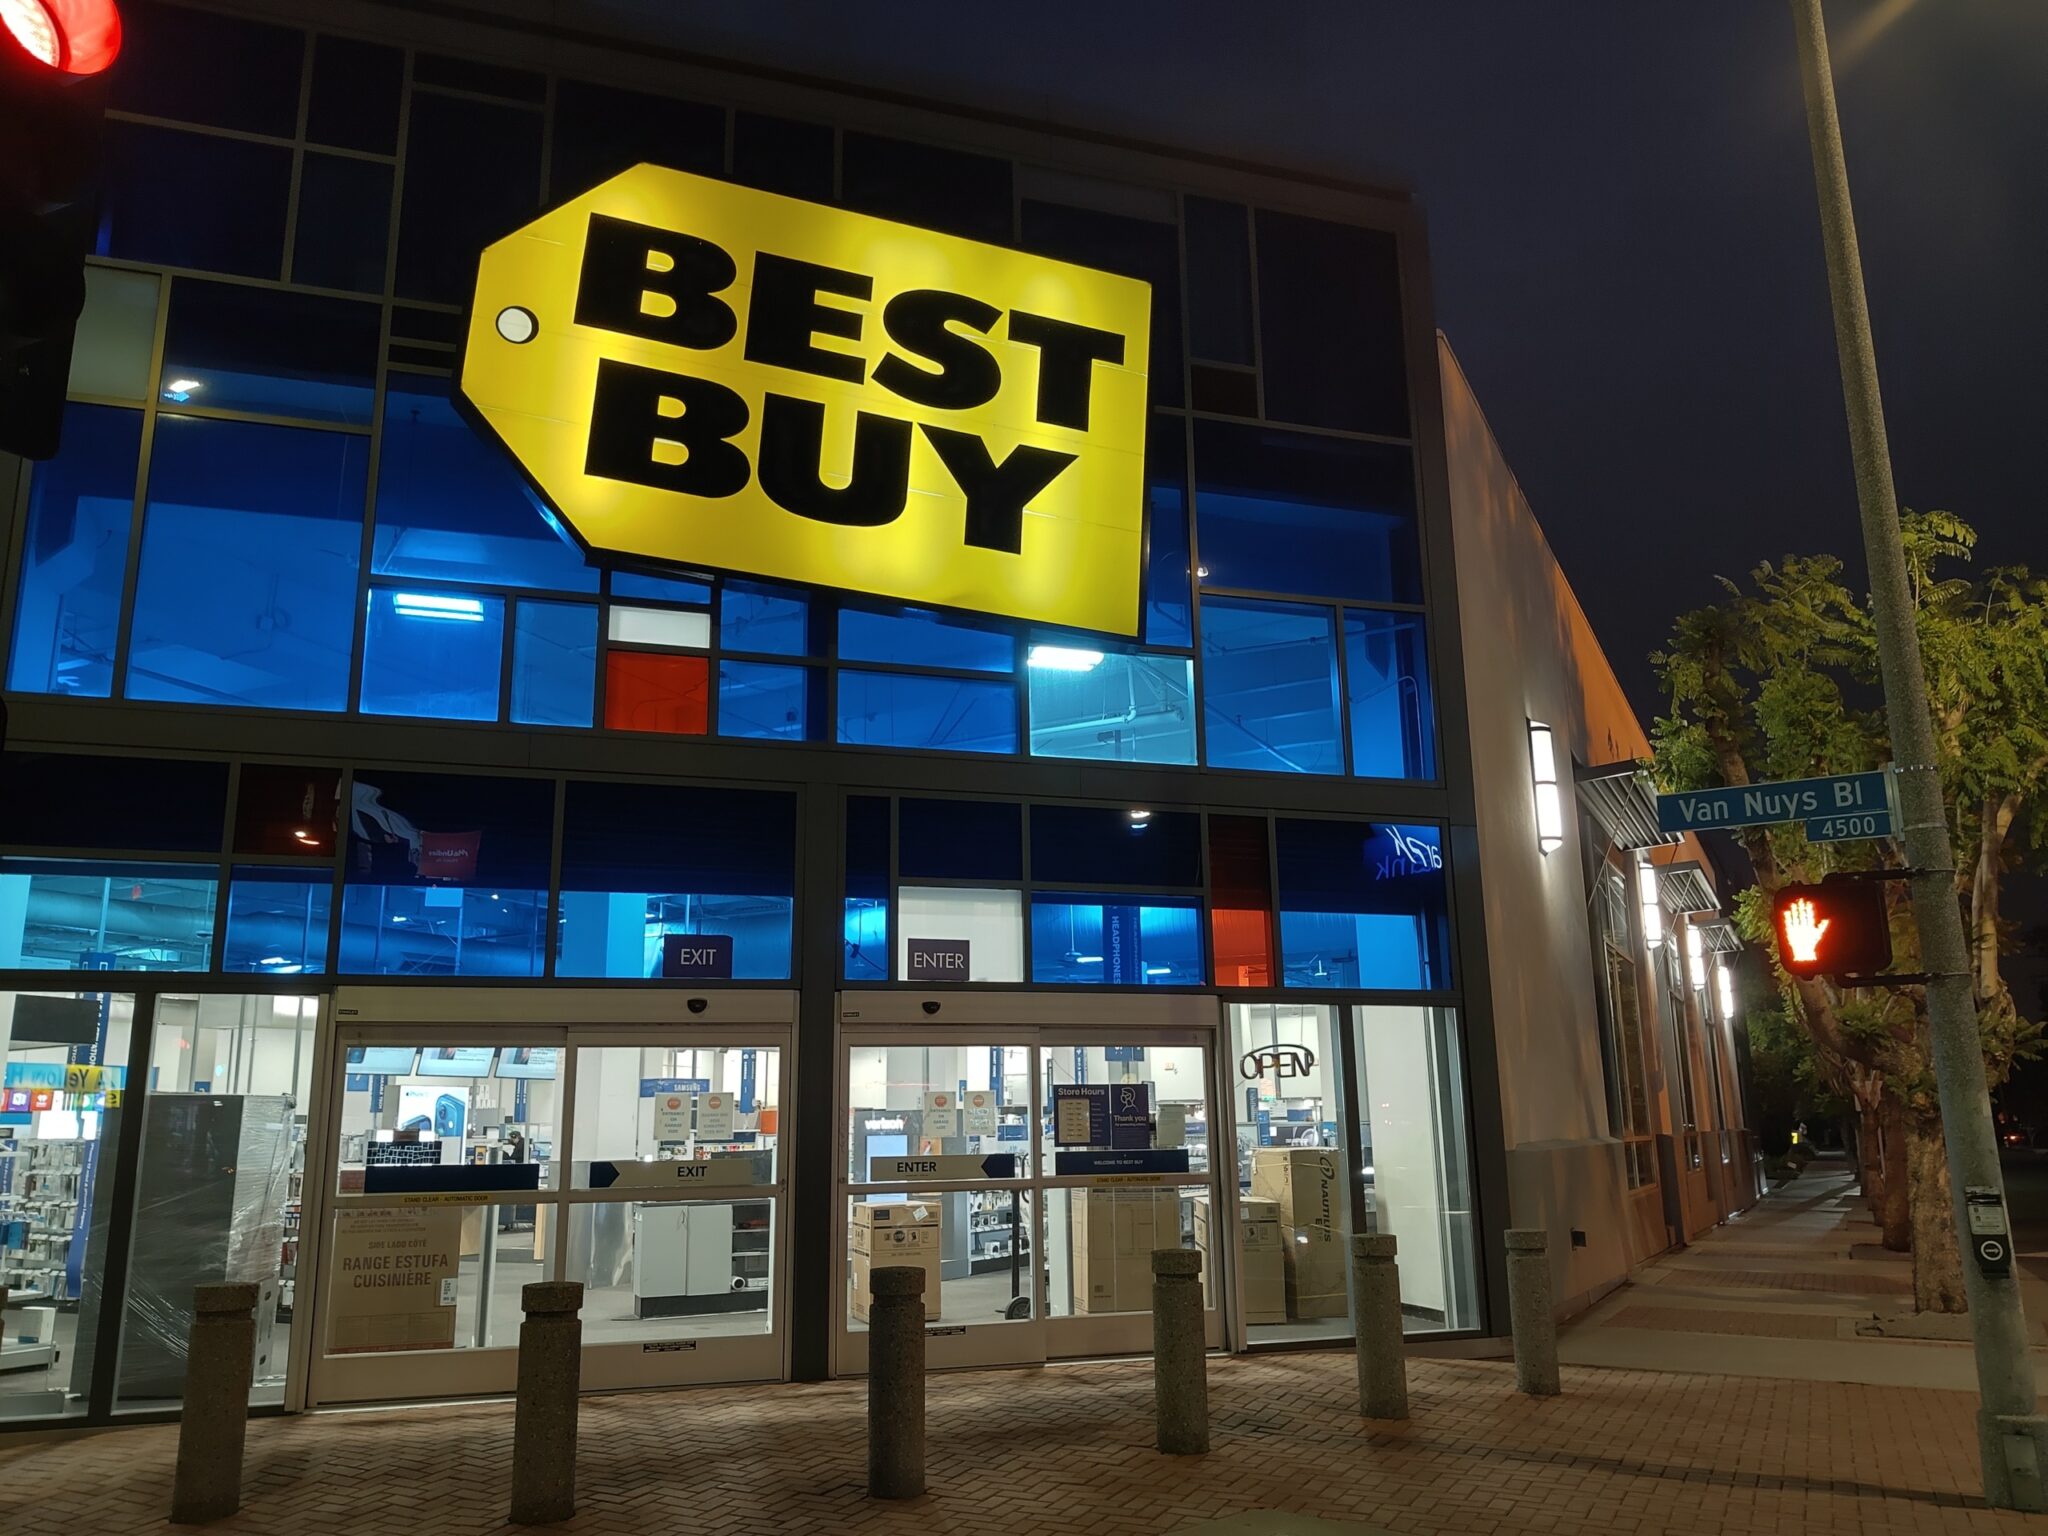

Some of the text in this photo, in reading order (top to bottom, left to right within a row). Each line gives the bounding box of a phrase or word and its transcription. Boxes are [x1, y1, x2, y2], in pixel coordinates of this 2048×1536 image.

[573, 212, 1126, 432] BEST
[583, 357, 1081, 555] BUY
[1679, 798, 1728, 823] Van
[1744, 787, 1818, 819] Nuys
[1821, 816, 1877, 838] 4500
[680, 948, 717, 966] EXIT
[1112, 915, 1121, 985] HEADPHONES
[913, 952, 965, 970] ENTER
[1240, 1050, 1313, 1079] OPEN
[674, 1083, 701, 1092] SAMSUNG
[1058, 1087, 1105, 1096] Store Hours
[865, 1117, 905, 1131] verizon
[677, 1166, 708, 1177] EXIT
[897, 1161, 937, 1173] ENTER
[1320, 1179, 1332, 1242] NAUTILUS
[343, 1253, 449, 1271] RANGE ESTUFA
[353, 1269, 432, 1288] CUISINIÈRE
